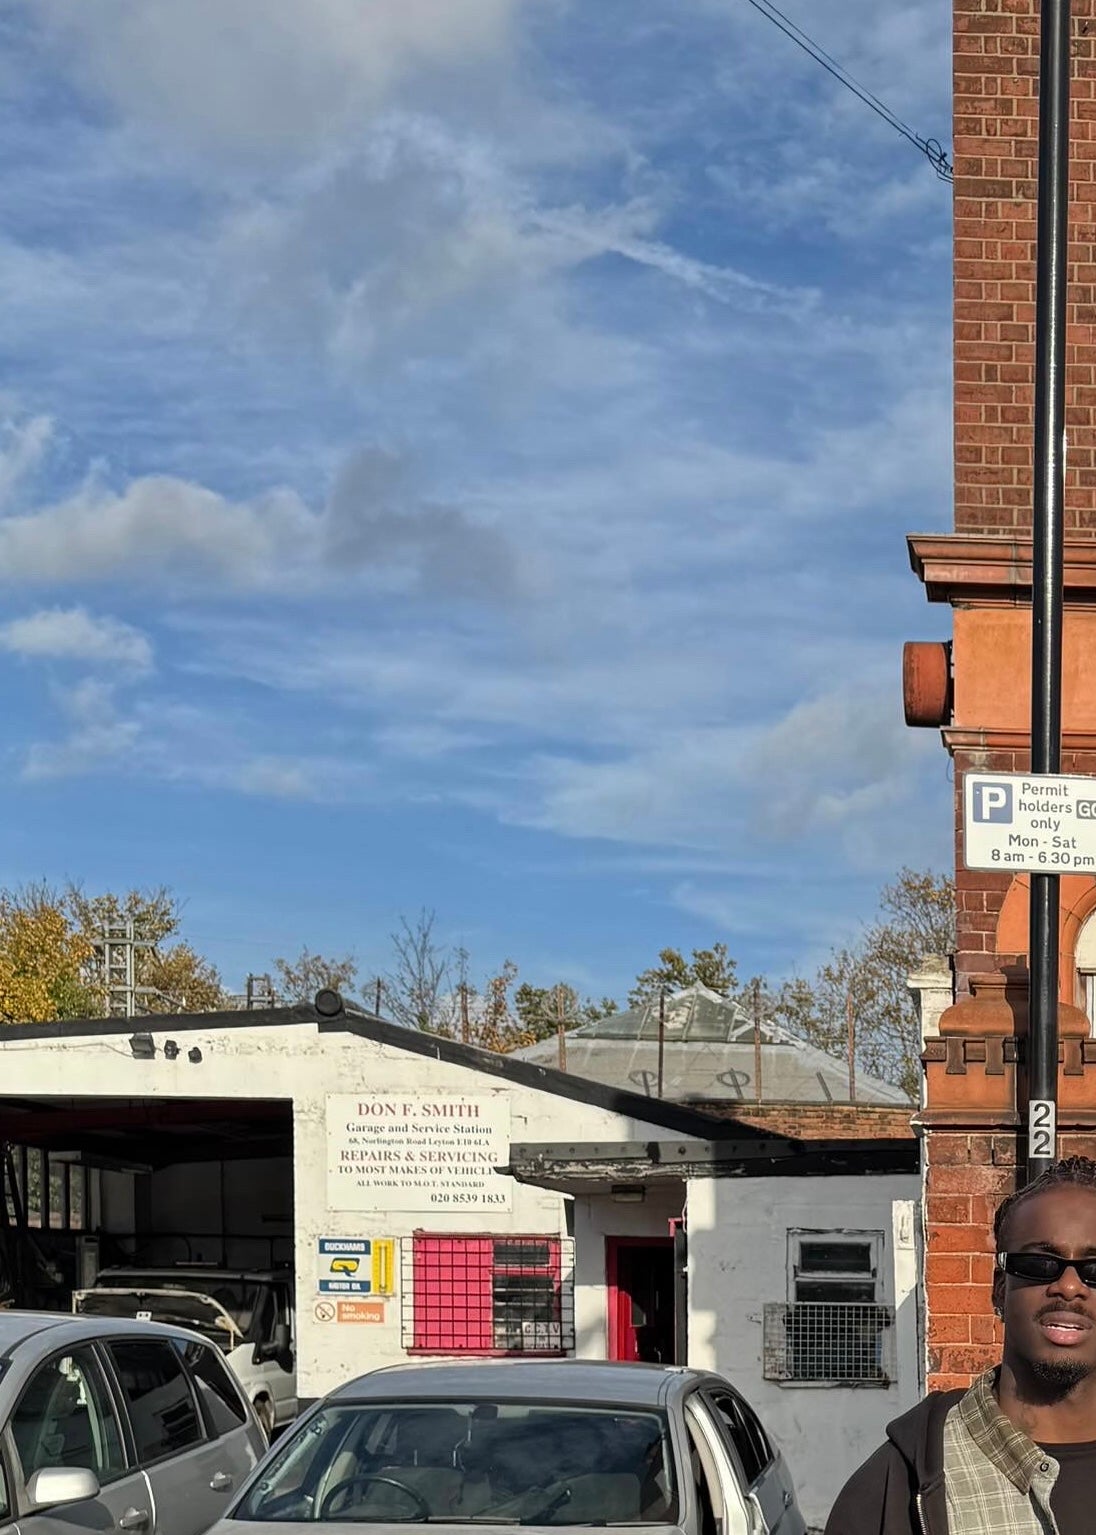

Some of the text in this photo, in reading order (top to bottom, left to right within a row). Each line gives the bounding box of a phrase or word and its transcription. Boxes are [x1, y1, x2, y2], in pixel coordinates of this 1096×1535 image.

[1022, 782, 1069, 797] Permit
[981, 786, 1007, 820] P
[1018, 799, 1073, 814] holders
[1030, 817, 1061, 832] only
[1008, 834, 1039, 847] Mon
[1052, 836, 1077, 849] Sat
[991, 849, 1000, 861] 8
[1004, 852, 1025, 863] am
[1073, 854, 1095, 867] pm
[358, 1102, 479, 1117] DON F. SMITH
[346, 1122, 492, 1134] Garage and Service Station
[341, 1149, 498, 1162] REPAIRS & SERVICING
[338, 1165, 353, 1174] TO
[355, 1165, 386, 1174] MOST
[389, 1165, 427, 1174] MAKES
[429, 1166, 444, 1174] OF
[430, 1193, 506, 1204] 020 8539 1833
[341, 1303, 355, 1311] No
[342, 1311, 380, 1322] smoking
